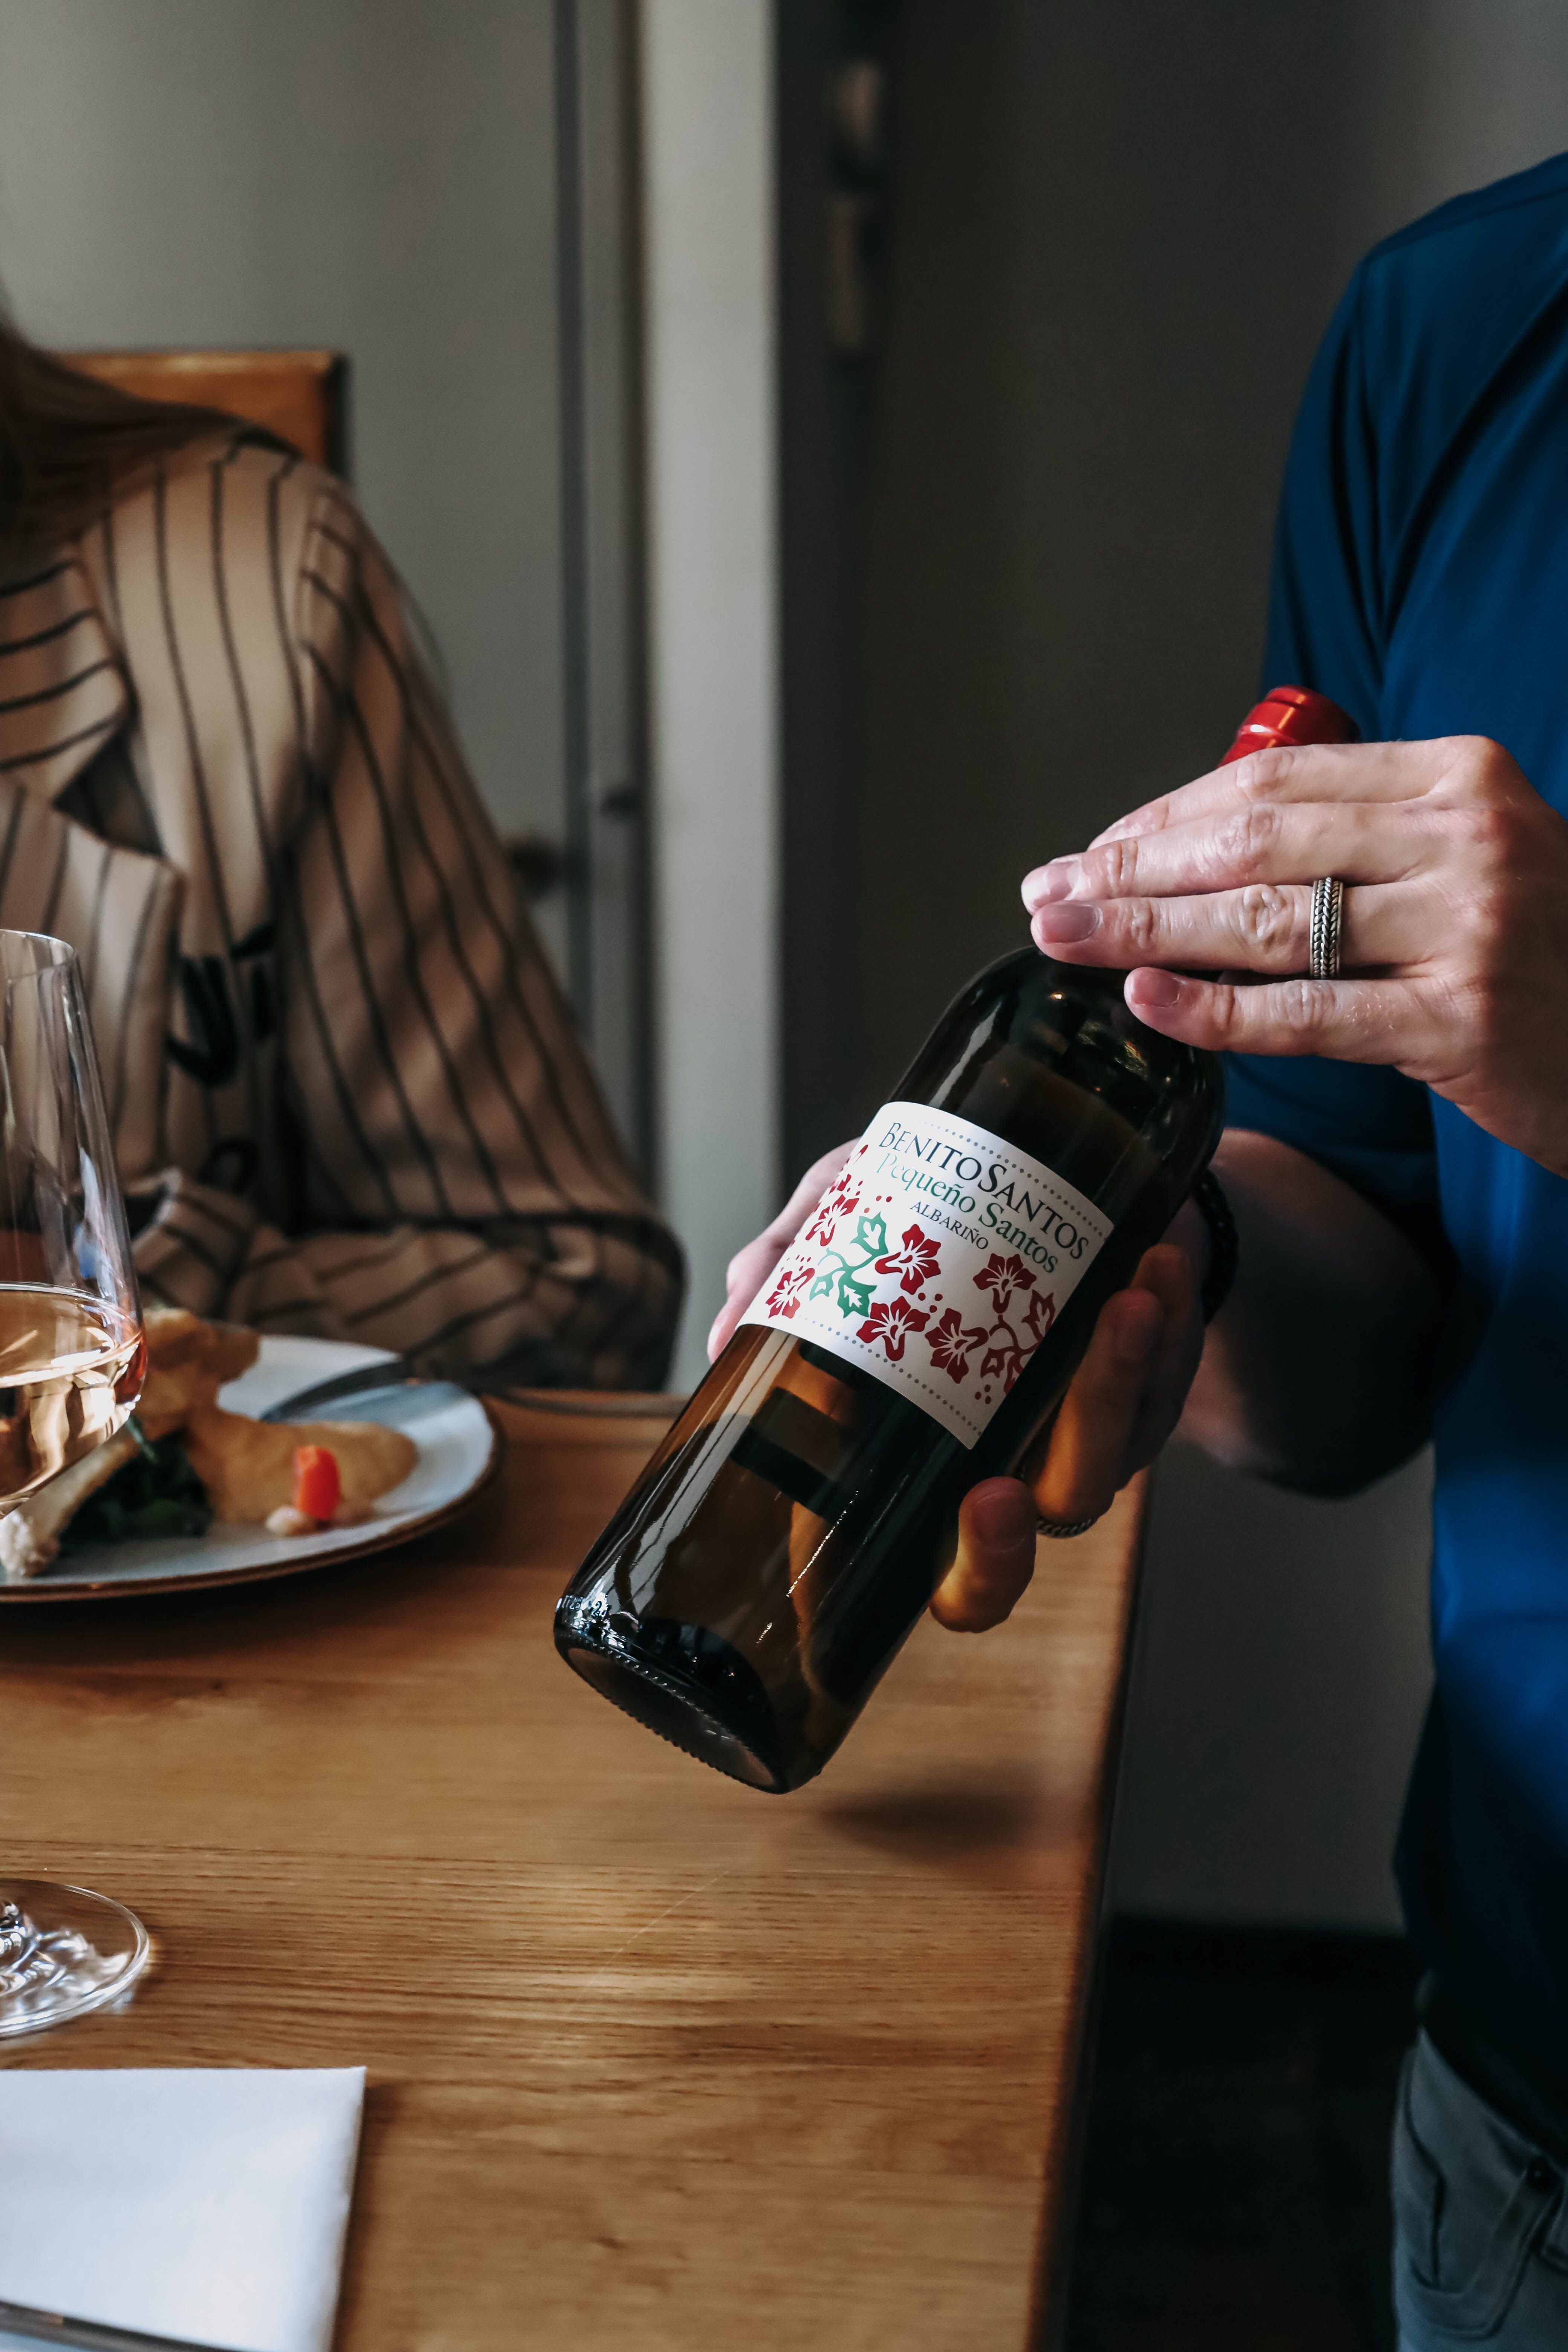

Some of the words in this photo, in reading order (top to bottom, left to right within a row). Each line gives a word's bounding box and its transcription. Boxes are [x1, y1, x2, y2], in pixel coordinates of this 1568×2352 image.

[874, 1153, 976, 1213] Pequeño
[978, 1202, 1058, 1273] Santos
[910, 1201, 989, 1250] ALBARIÑO
